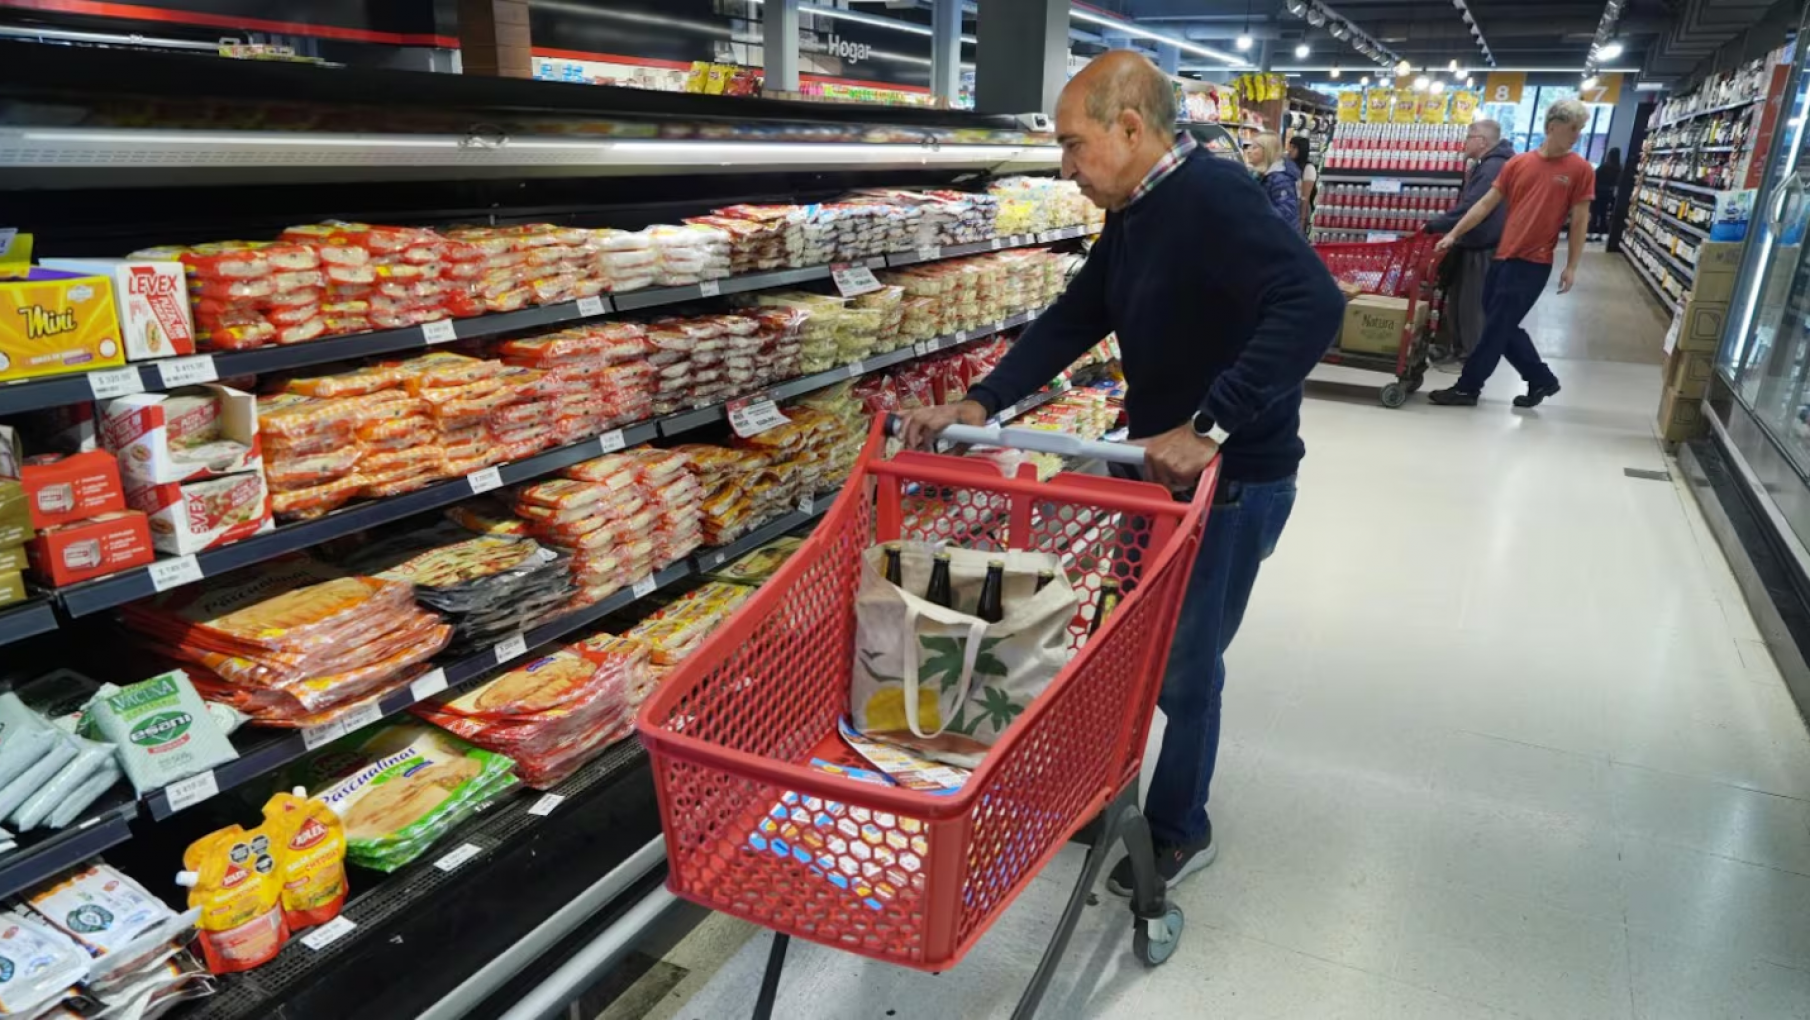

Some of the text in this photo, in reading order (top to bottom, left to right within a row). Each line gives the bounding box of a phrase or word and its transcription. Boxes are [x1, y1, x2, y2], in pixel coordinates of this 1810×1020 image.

[828, 33, 872, 64] Hogar
[1495, 85, 1509, 101] 8
[1592, 86, 1609, 102] 7
[128, 273, 177, 295] LEVEX
[18, 305, 77, 339] Mini
[1361, 313, 1395, 330] Natura
[131, 714, 192, 741] esani
